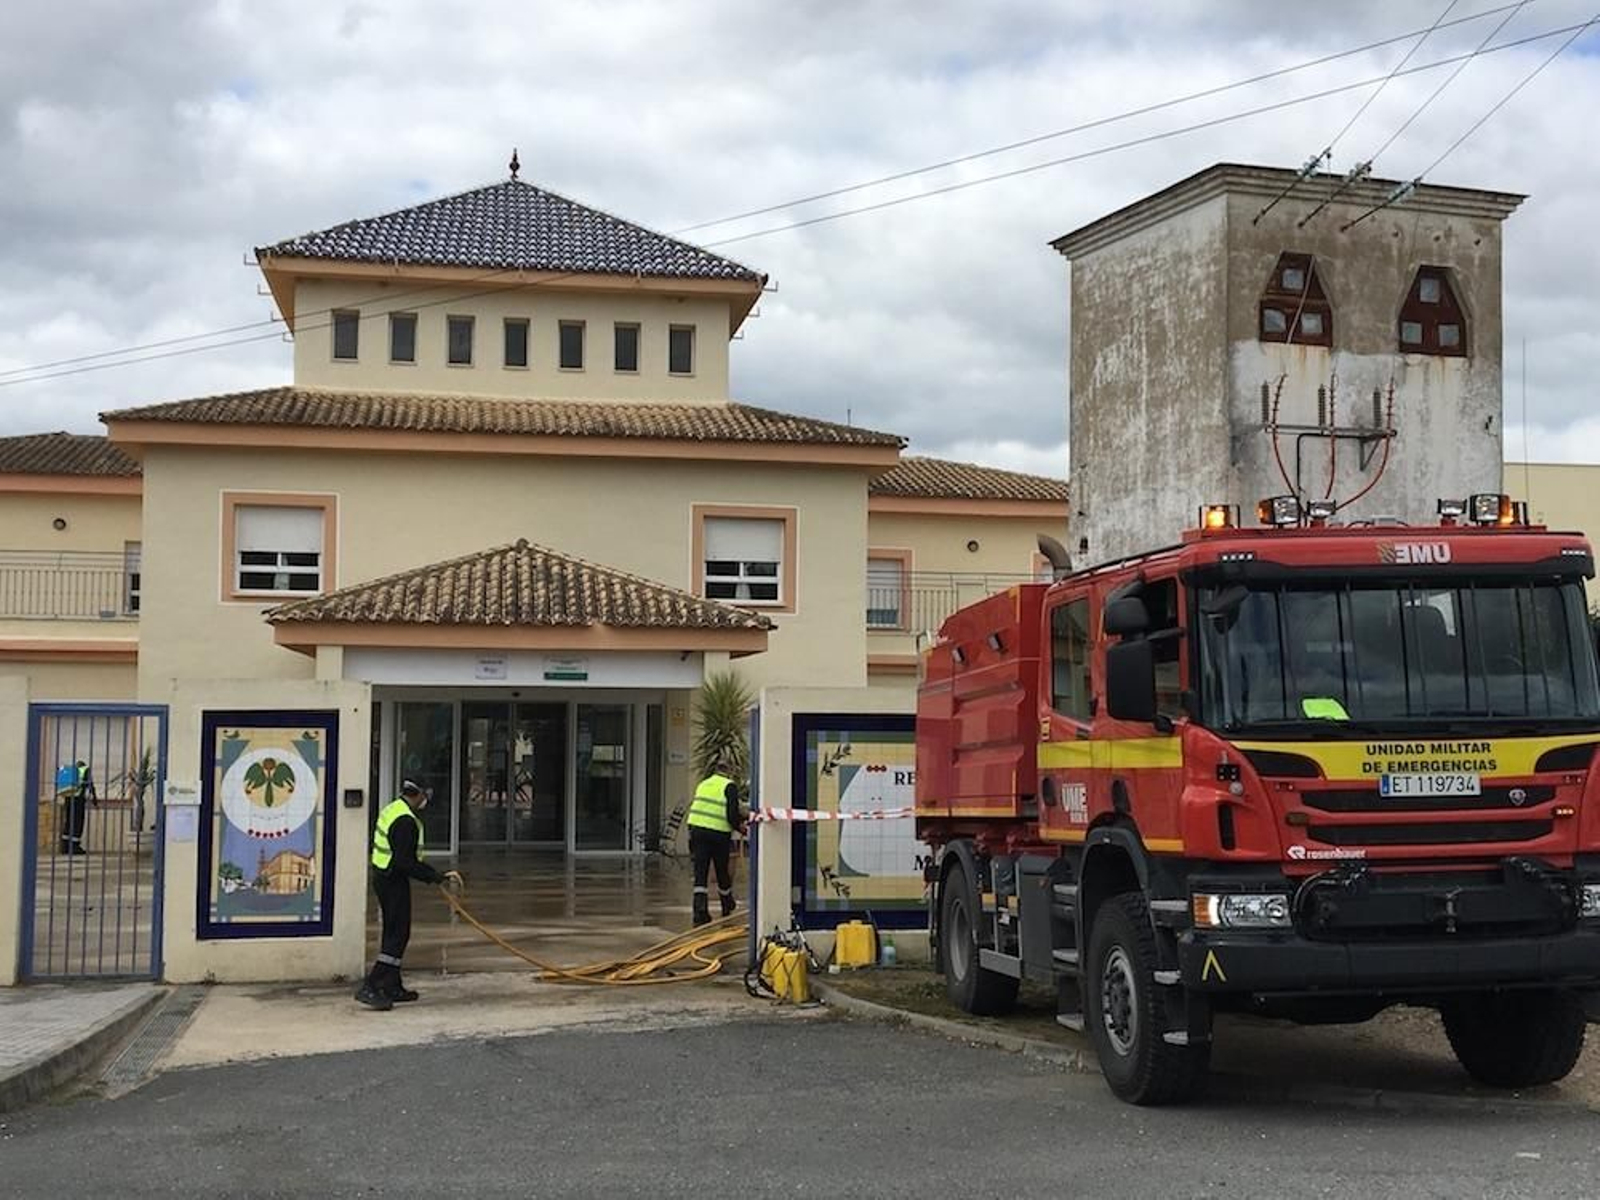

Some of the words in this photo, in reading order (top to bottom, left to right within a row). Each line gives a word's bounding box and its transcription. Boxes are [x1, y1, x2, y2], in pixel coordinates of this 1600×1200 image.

[1366, 744, 1425, 755] UNIDAD
[1431, 743, 1491, 754] MILITAR
[1362, 762, 1382, 773] DE
[1388, 760, 1497, 772] EMERGENCIAS
[1392, 776, 1411, 793] ET
[1418, 776, 1475, 793] 119734
[1062, 783, 1087, 811] UME
[1307, 848, 1366, 859] rosenbauer
